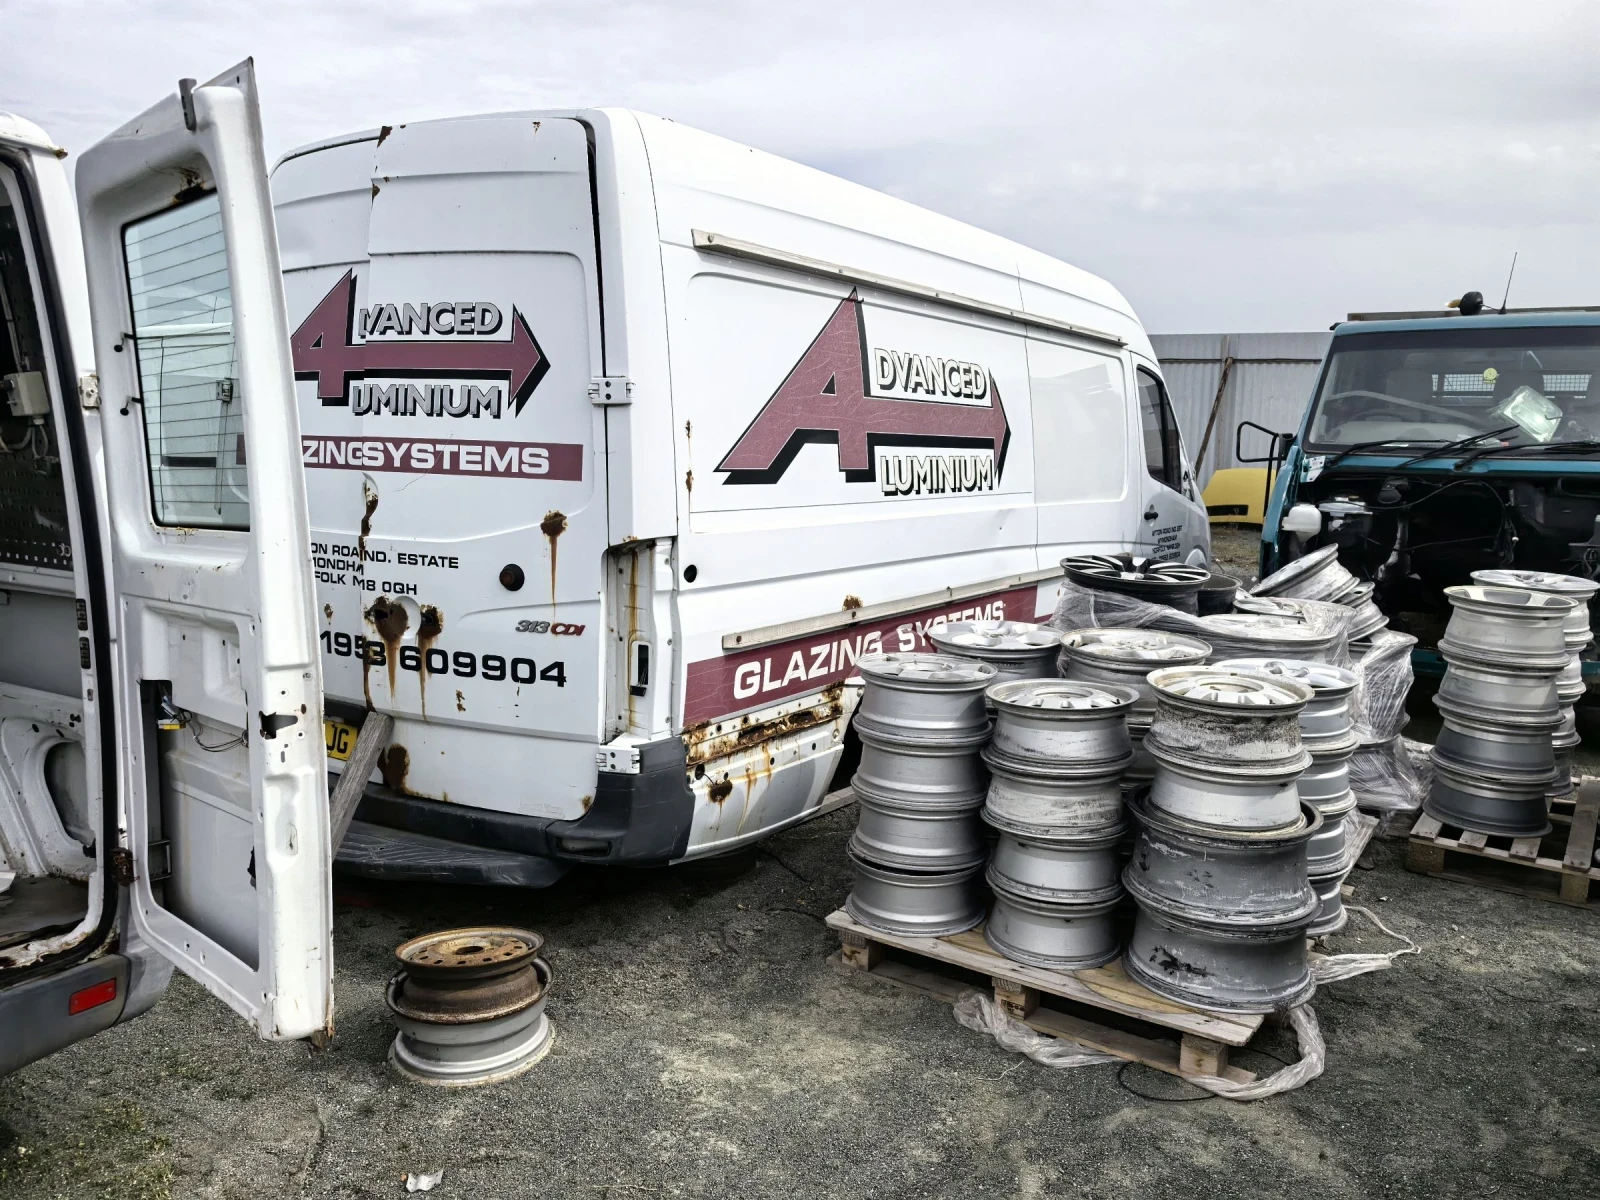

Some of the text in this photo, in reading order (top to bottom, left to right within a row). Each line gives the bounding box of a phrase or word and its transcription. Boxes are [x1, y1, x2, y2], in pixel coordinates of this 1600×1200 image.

[874, 348, 987, 399] DVANCED
[880, 455, 994, 496] LUMINIUM
[397, 552, 459, 569] ESTATE
[515, 620, 586, 636] 313 CDI
[400, 645, 567, 688] 609904
[734, 631, 883, 699] GLAZING
